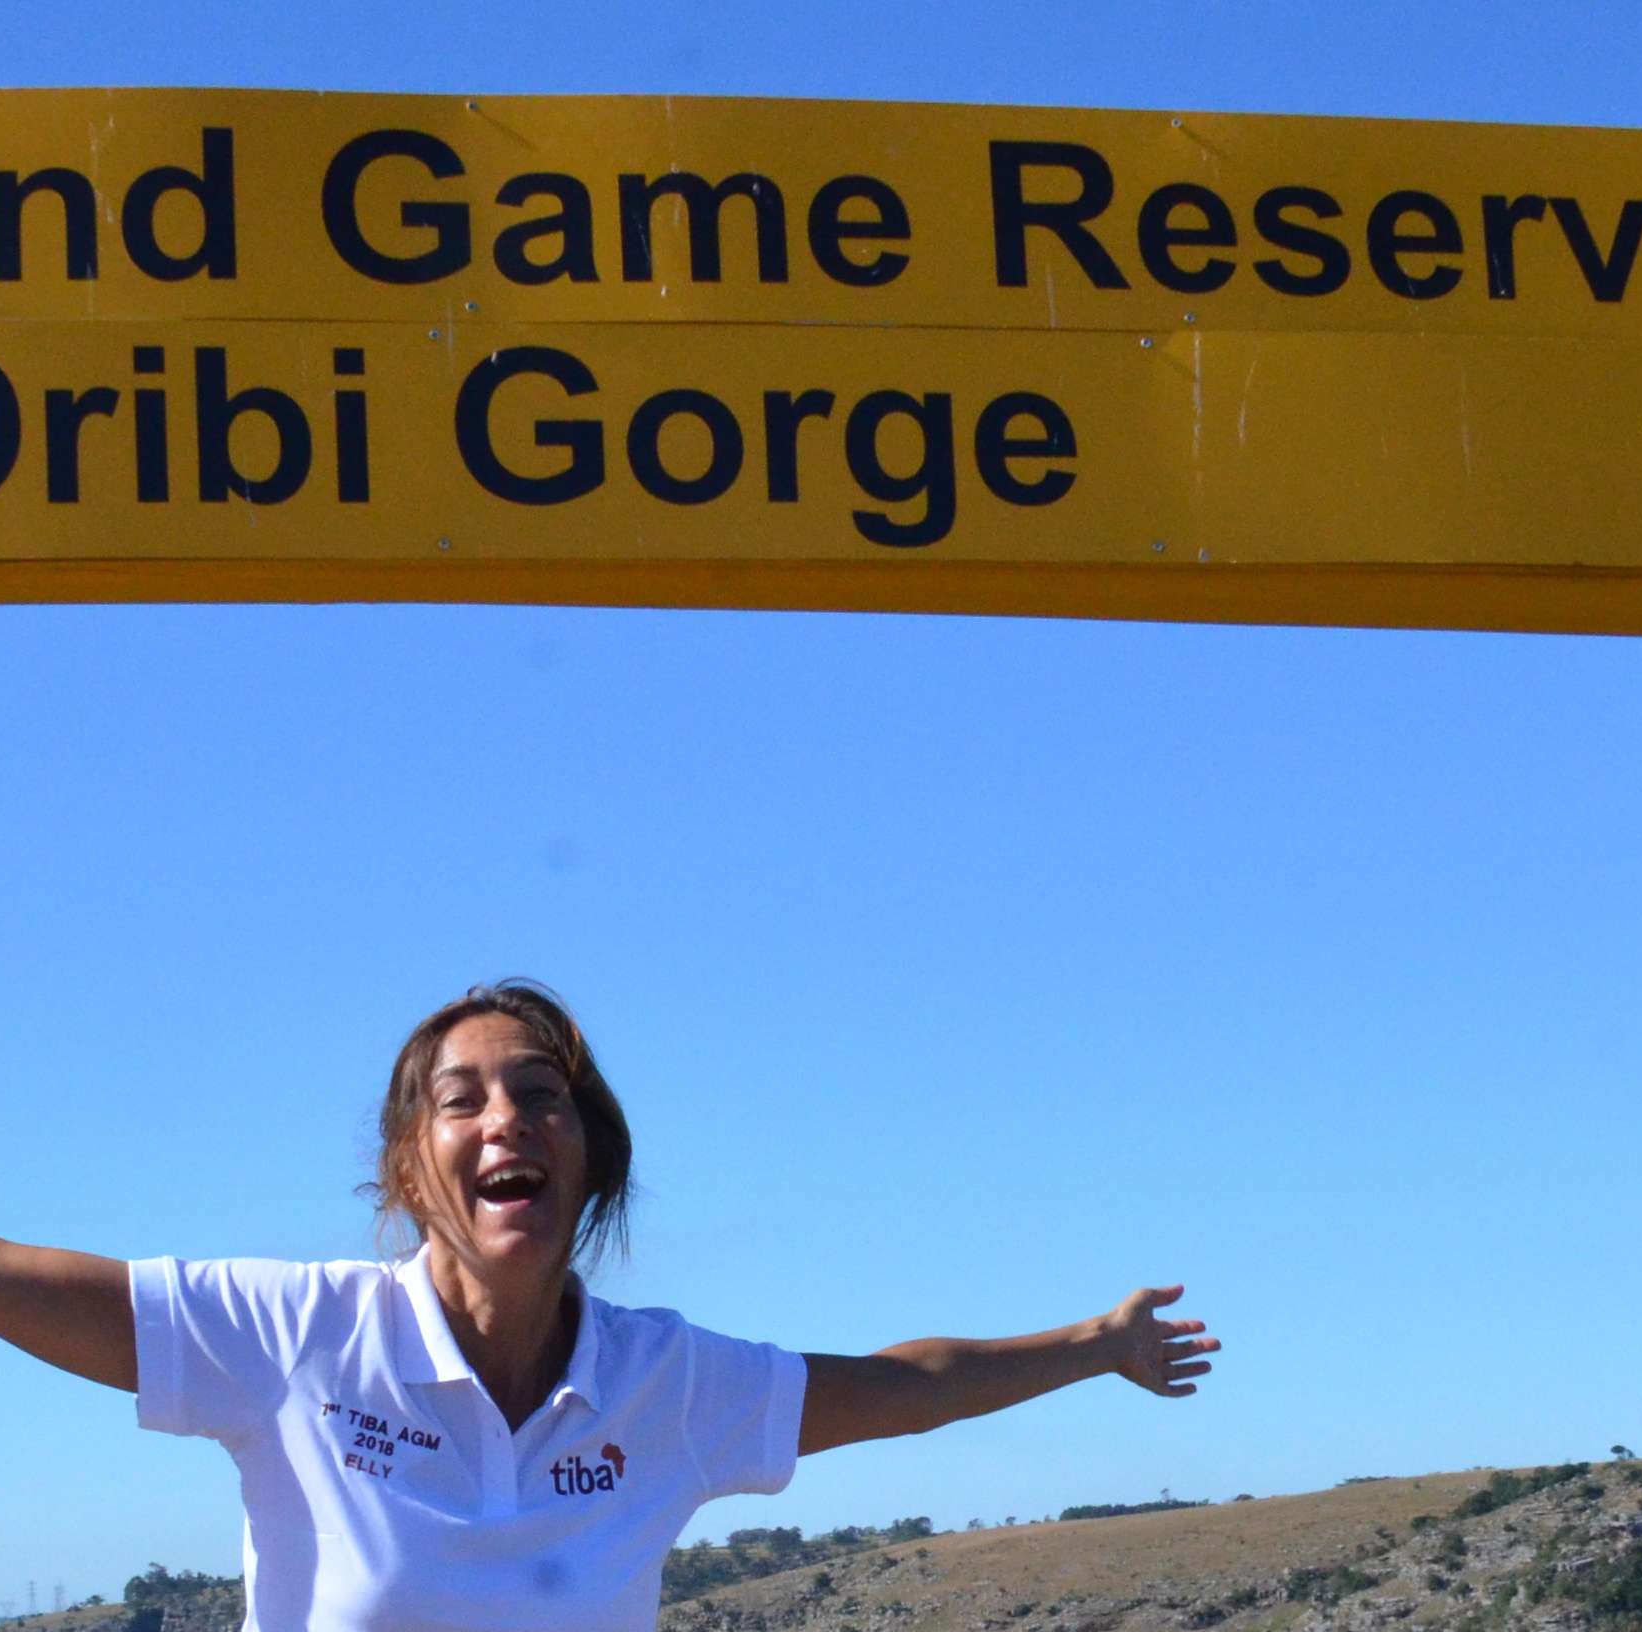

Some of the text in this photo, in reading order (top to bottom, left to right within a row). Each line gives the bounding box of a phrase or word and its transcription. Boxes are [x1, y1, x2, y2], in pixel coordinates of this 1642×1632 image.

[321, 127, 912, 287] Game
[454, 345, 1078, 549] Gorge
[349, 1410, 388, 1435] TIBA
[398, 1427, 441, 1450] AGM
[354, 1432, 395, 1456] 2018
[345, 1453, 393, 1479] ELLY
[550, 1455, 614, 1495] tiba
